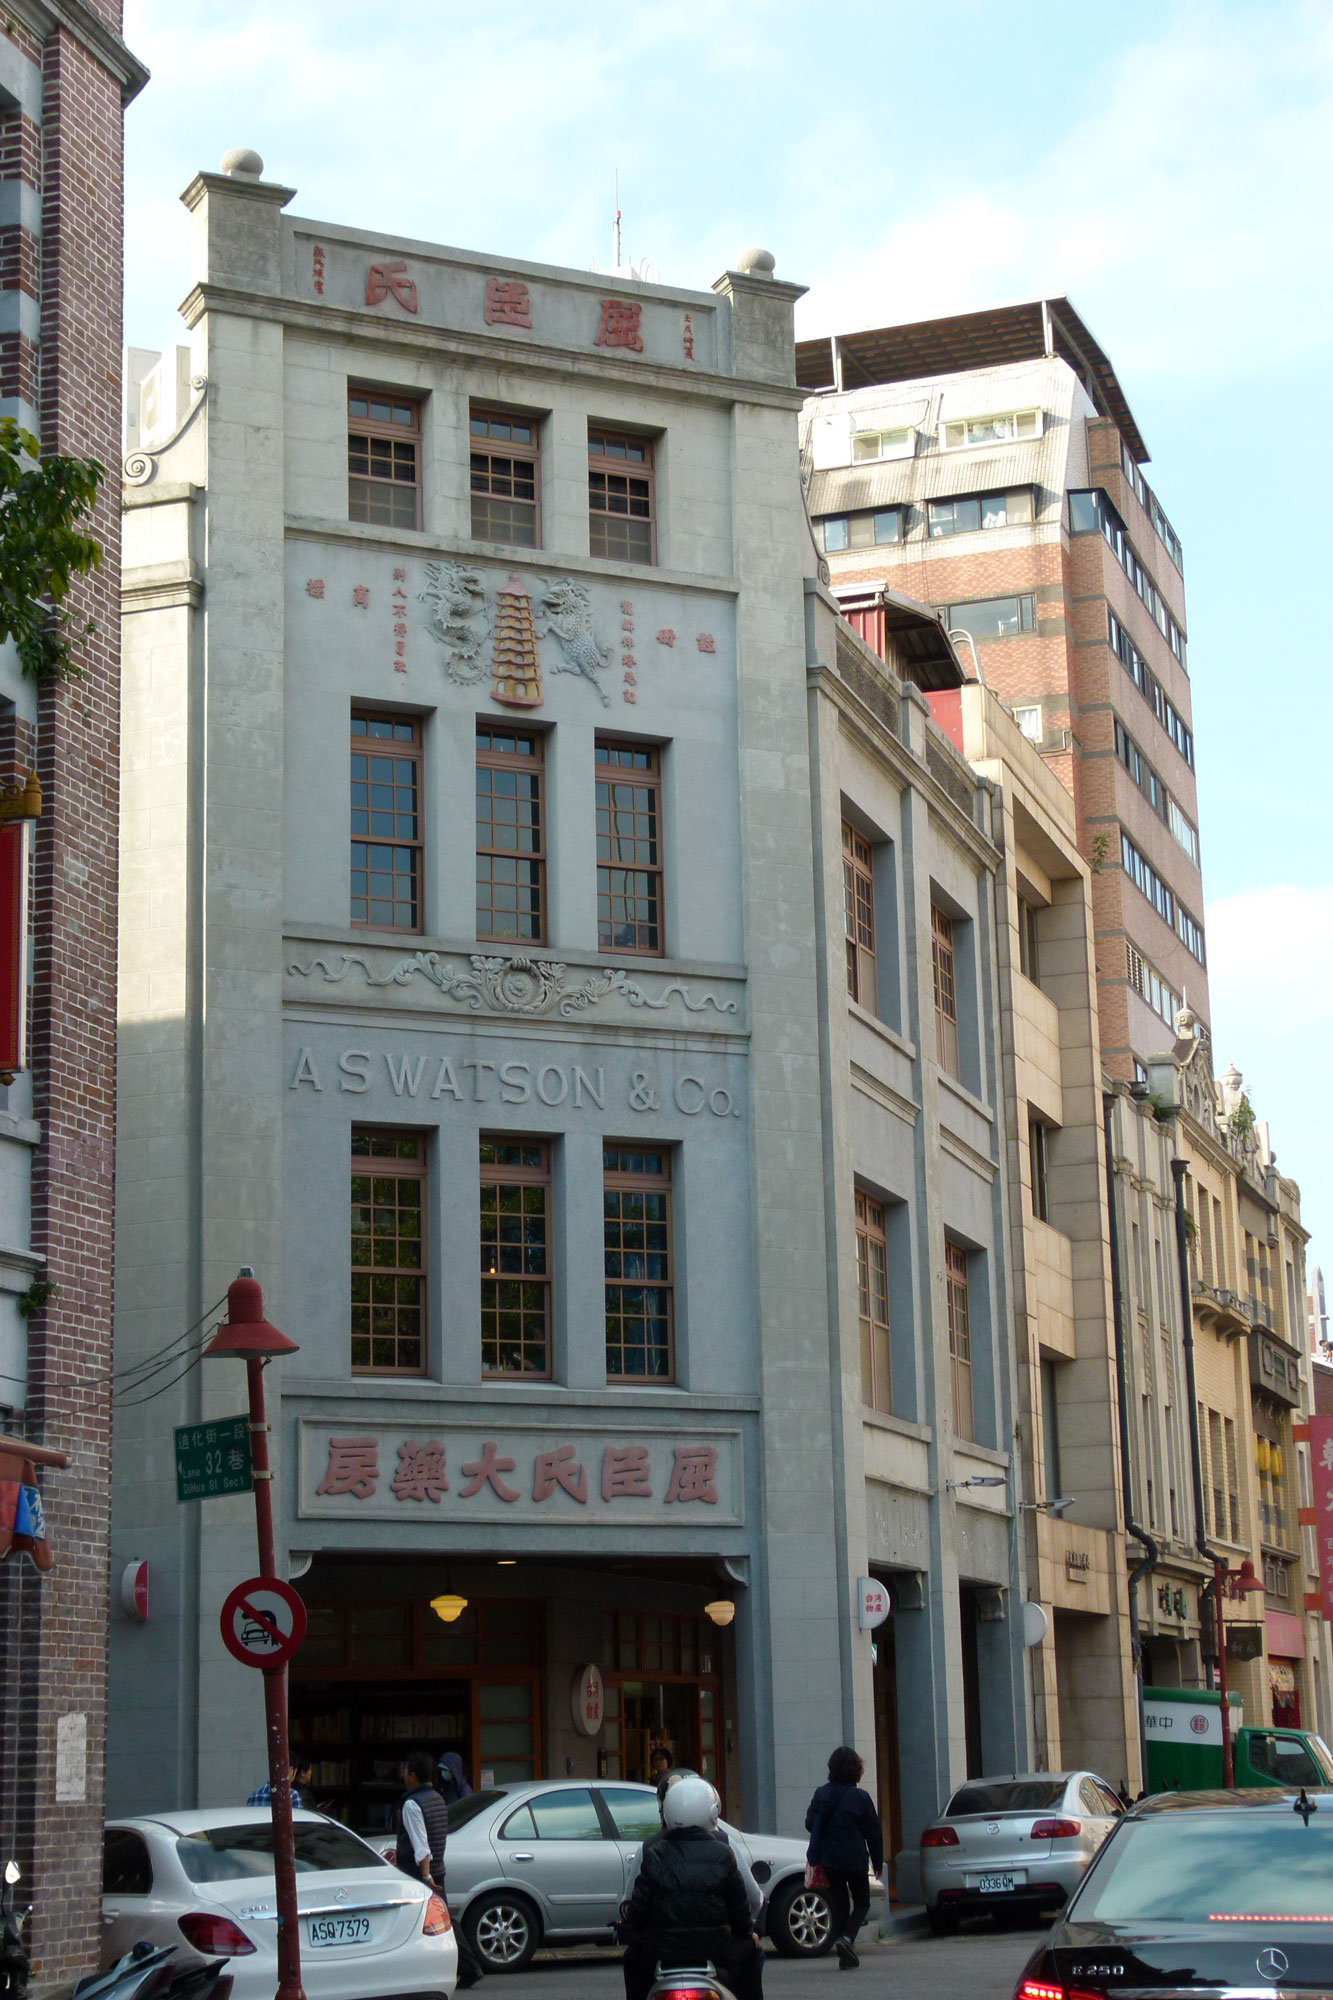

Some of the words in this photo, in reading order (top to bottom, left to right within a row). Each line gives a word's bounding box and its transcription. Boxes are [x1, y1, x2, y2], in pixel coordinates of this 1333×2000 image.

[364, 260, 645, 352] 屈臣氏
[288, 1047, 323, 1092] A
[338, 1050, 373, 1094] S
[383, 1053, 605, 1111] WATSON
[628, 1070, 661, 1113] &
[675, 1074, 741, 1119] Co.
[178, 1423, 245, 1450] 迪化街一段
[183, 1468, 201, 1479] Lane
[206, 1449, 222, 1475] 32
[228, 1447, 245, 1470] 巷
[315, 1436, 719, 1503] 屈臣氏大藥房
[1072, 1965, 1082, 1975] E
[1086, 1964, 1124, 1975] 250
